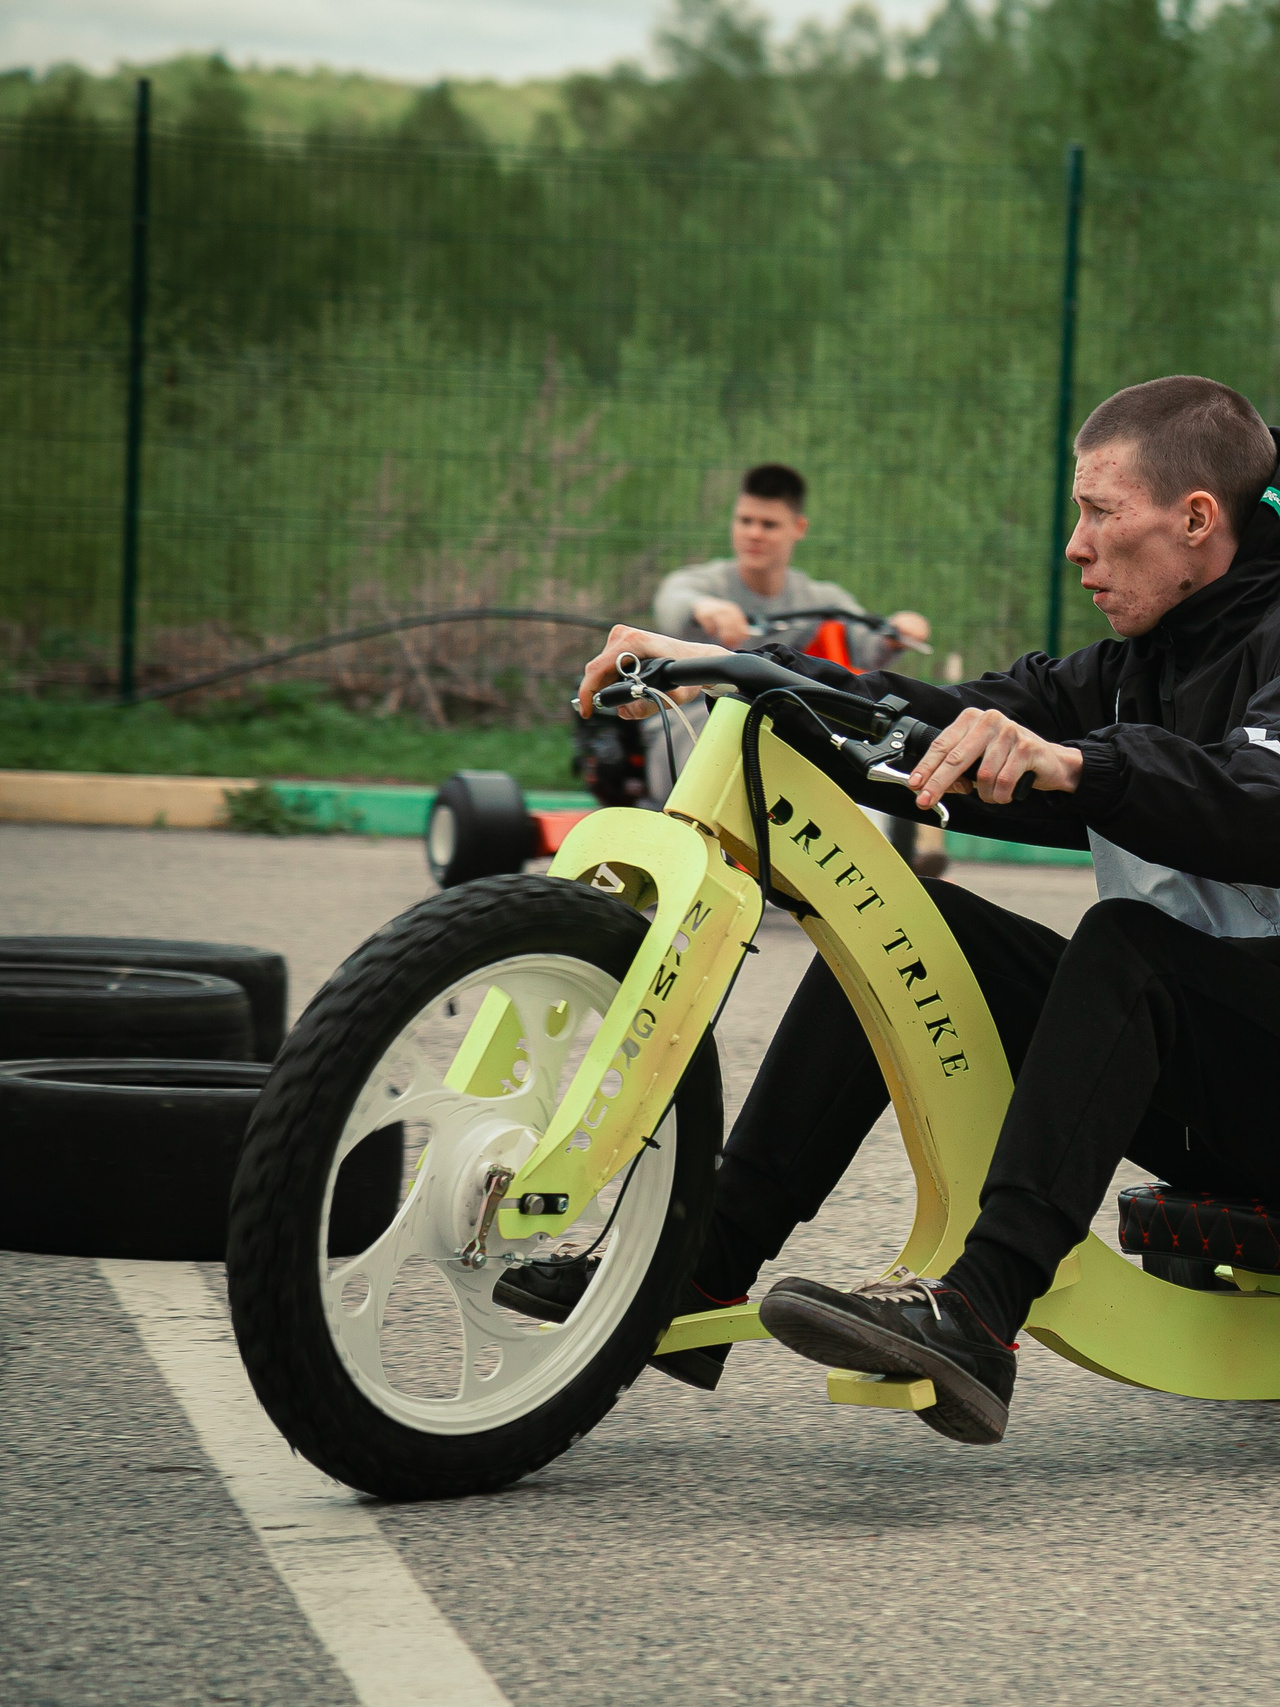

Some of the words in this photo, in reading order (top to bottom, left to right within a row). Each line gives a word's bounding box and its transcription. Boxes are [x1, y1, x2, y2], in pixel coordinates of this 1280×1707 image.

[768, 794, 886, 915] DRIFT
[881, 927, 970, 1078] TRIKE
[565, 1008, 657, 1154] GROUP
